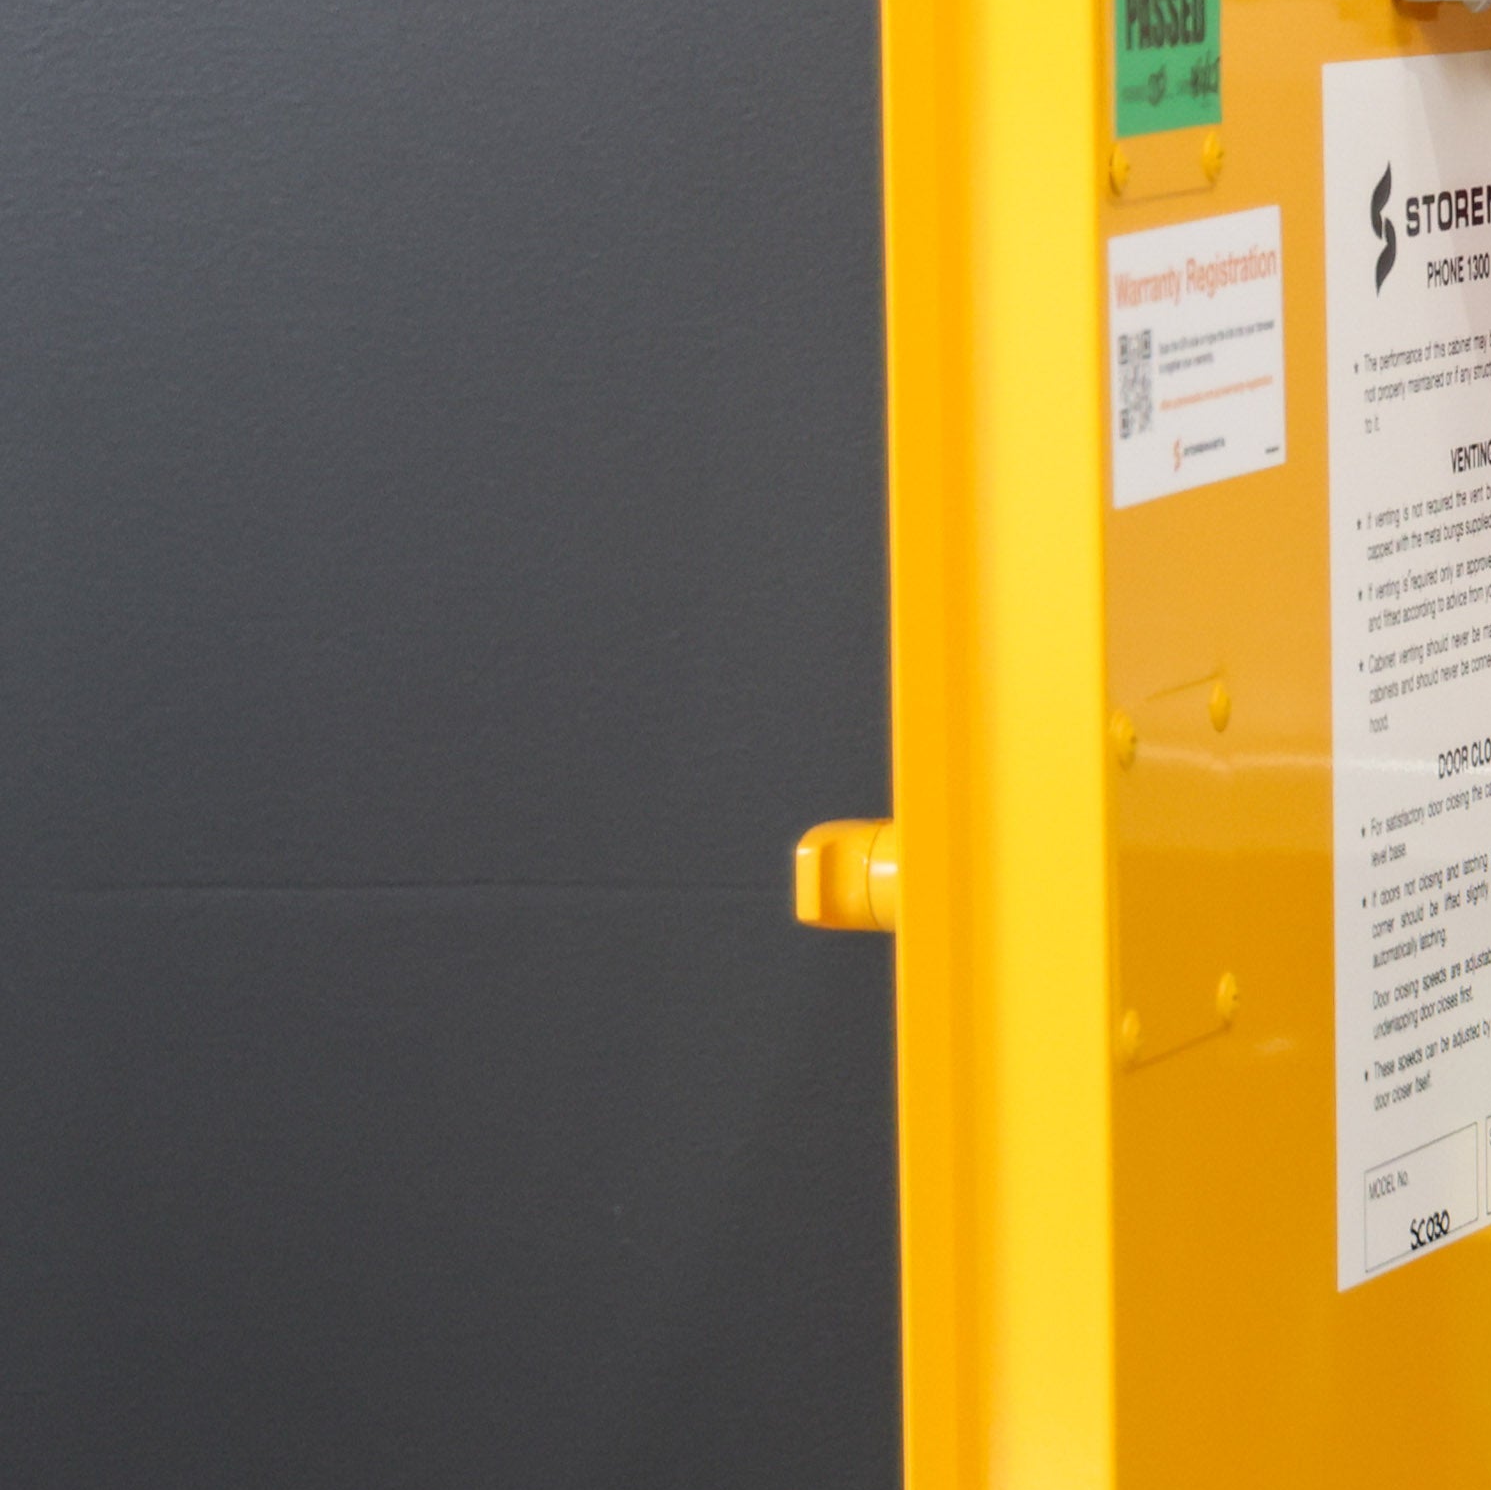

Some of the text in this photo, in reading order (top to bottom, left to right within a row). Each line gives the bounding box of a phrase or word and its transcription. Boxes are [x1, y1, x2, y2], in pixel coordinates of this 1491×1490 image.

[1114, 245, 1277, 310] Warranty Registration
[1427, 255, 1464, 288] PHONE
[1467, 252, 1491, 281] 1300
[1437, 745, 1468, 780] DOOR
[1368, 1173, 1395, 1200] MODEL
